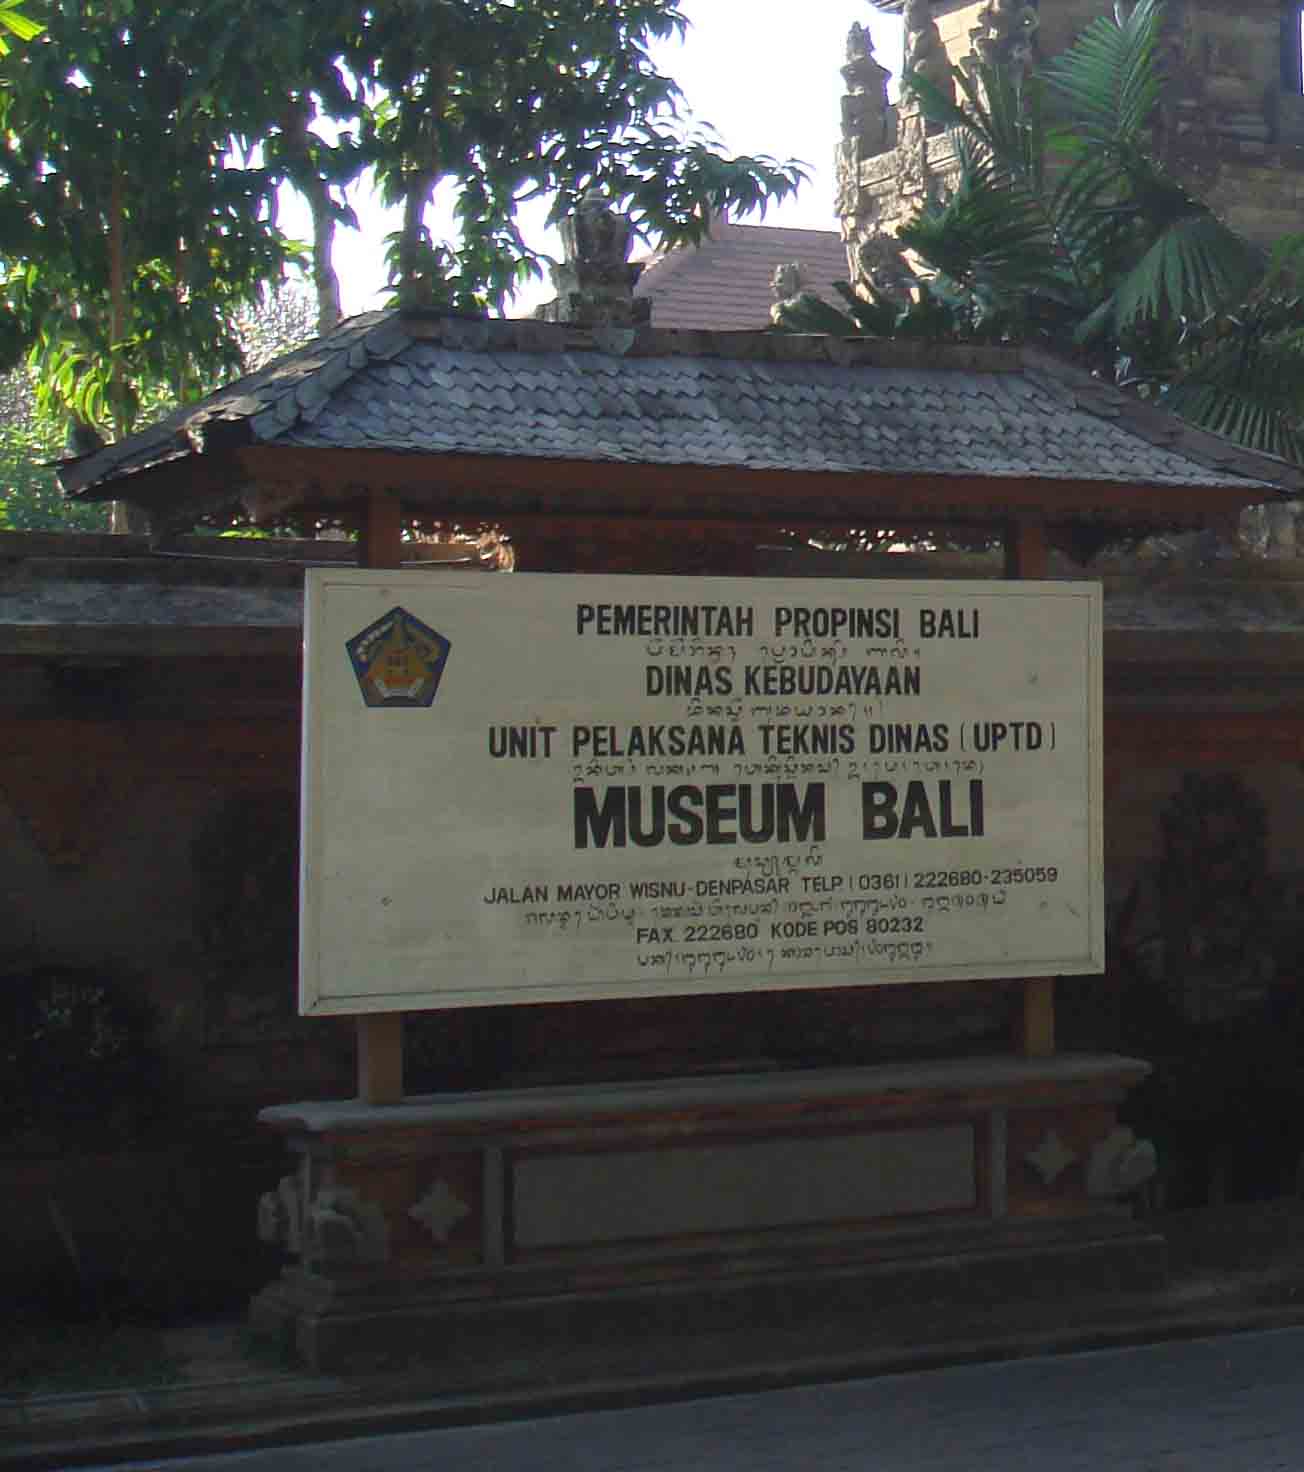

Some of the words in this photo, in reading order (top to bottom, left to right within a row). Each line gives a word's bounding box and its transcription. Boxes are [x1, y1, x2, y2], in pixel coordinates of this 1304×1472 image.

[576, 603, 753, 636] PEMERINTAH
[775, 607, 900, 638] PROPINSI
[919, 608, 980, 638] BALI
[646, 665, 732, 696] DINAS
[744, 665, 921, 696] KEBUDAYAAN
[488, 726, 559, 758] UNIT
[573, 725, 745, 756] PELAKSANA
[758, 723, 855, 755] TEKNIS
[870, 723, 949, 754] DINAS
[574, 782, 826, 849] MUSEUM
[862, 779, 985, 841] BALI
[484, 885, 549, 904] JALAN
[557, 883, 621, 902] MAYOR
[801, 876, 843, 893] TELP
[684, 924, 759, 943] 222680
[771, 920, 817, 939] KODE
[823, 919, 859, 937] POS
[865, 916, 925, 935] 80232
